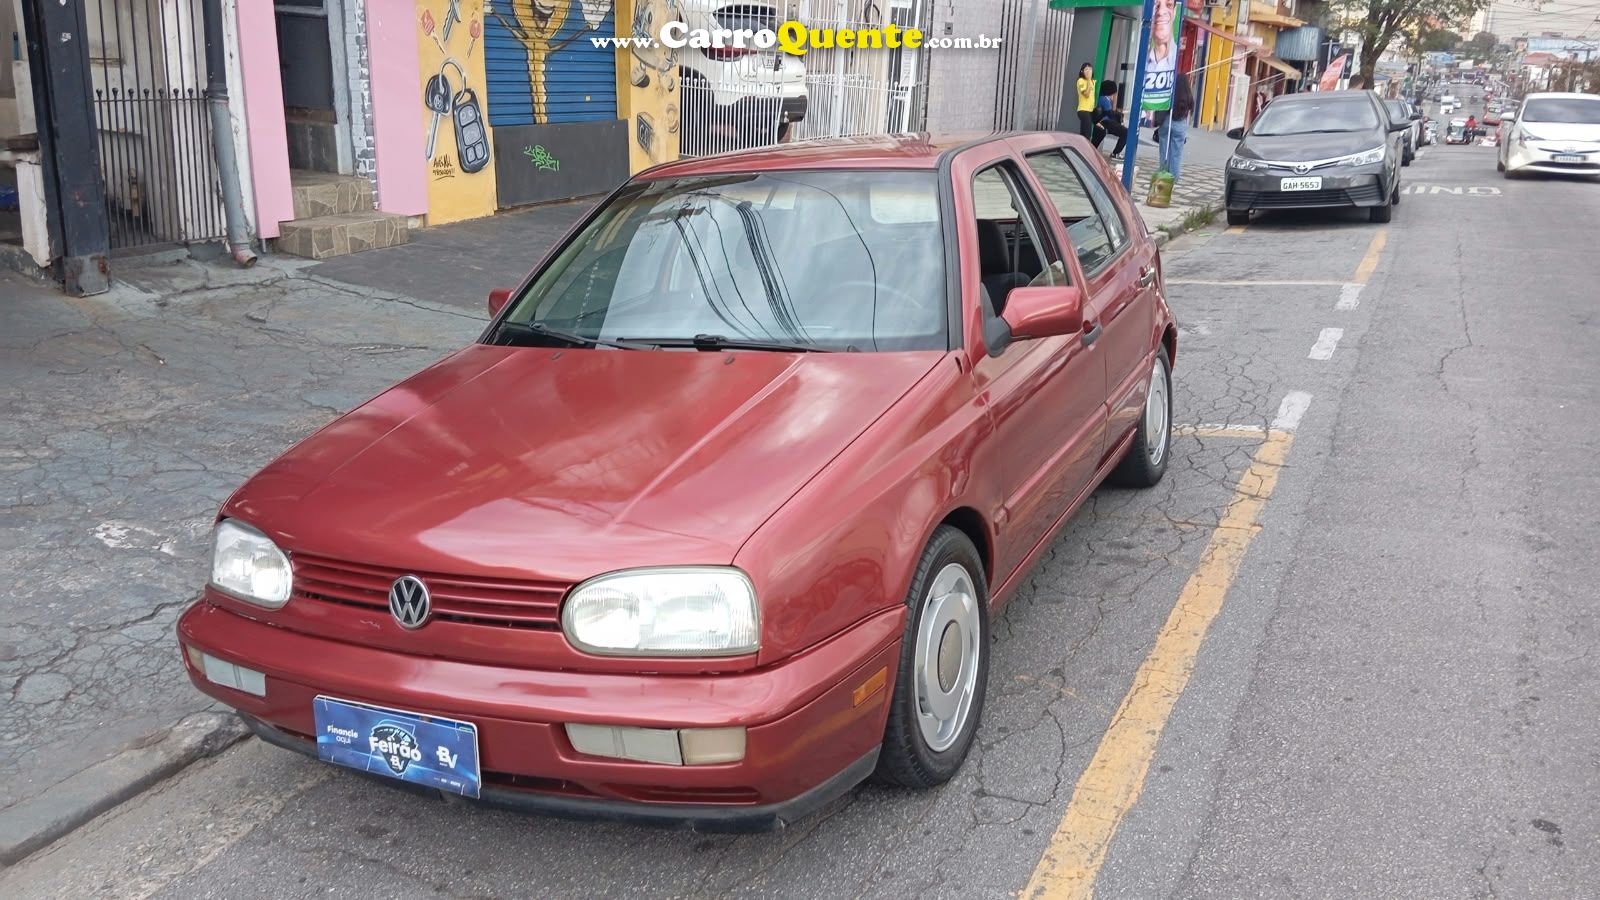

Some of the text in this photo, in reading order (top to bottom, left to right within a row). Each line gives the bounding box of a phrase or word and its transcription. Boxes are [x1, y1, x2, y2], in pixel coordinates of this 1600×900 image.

[327, 724, 359, 739] Financie
[369, 735, 422, 762] Feirão
[436, 745, 458, 769] BV
